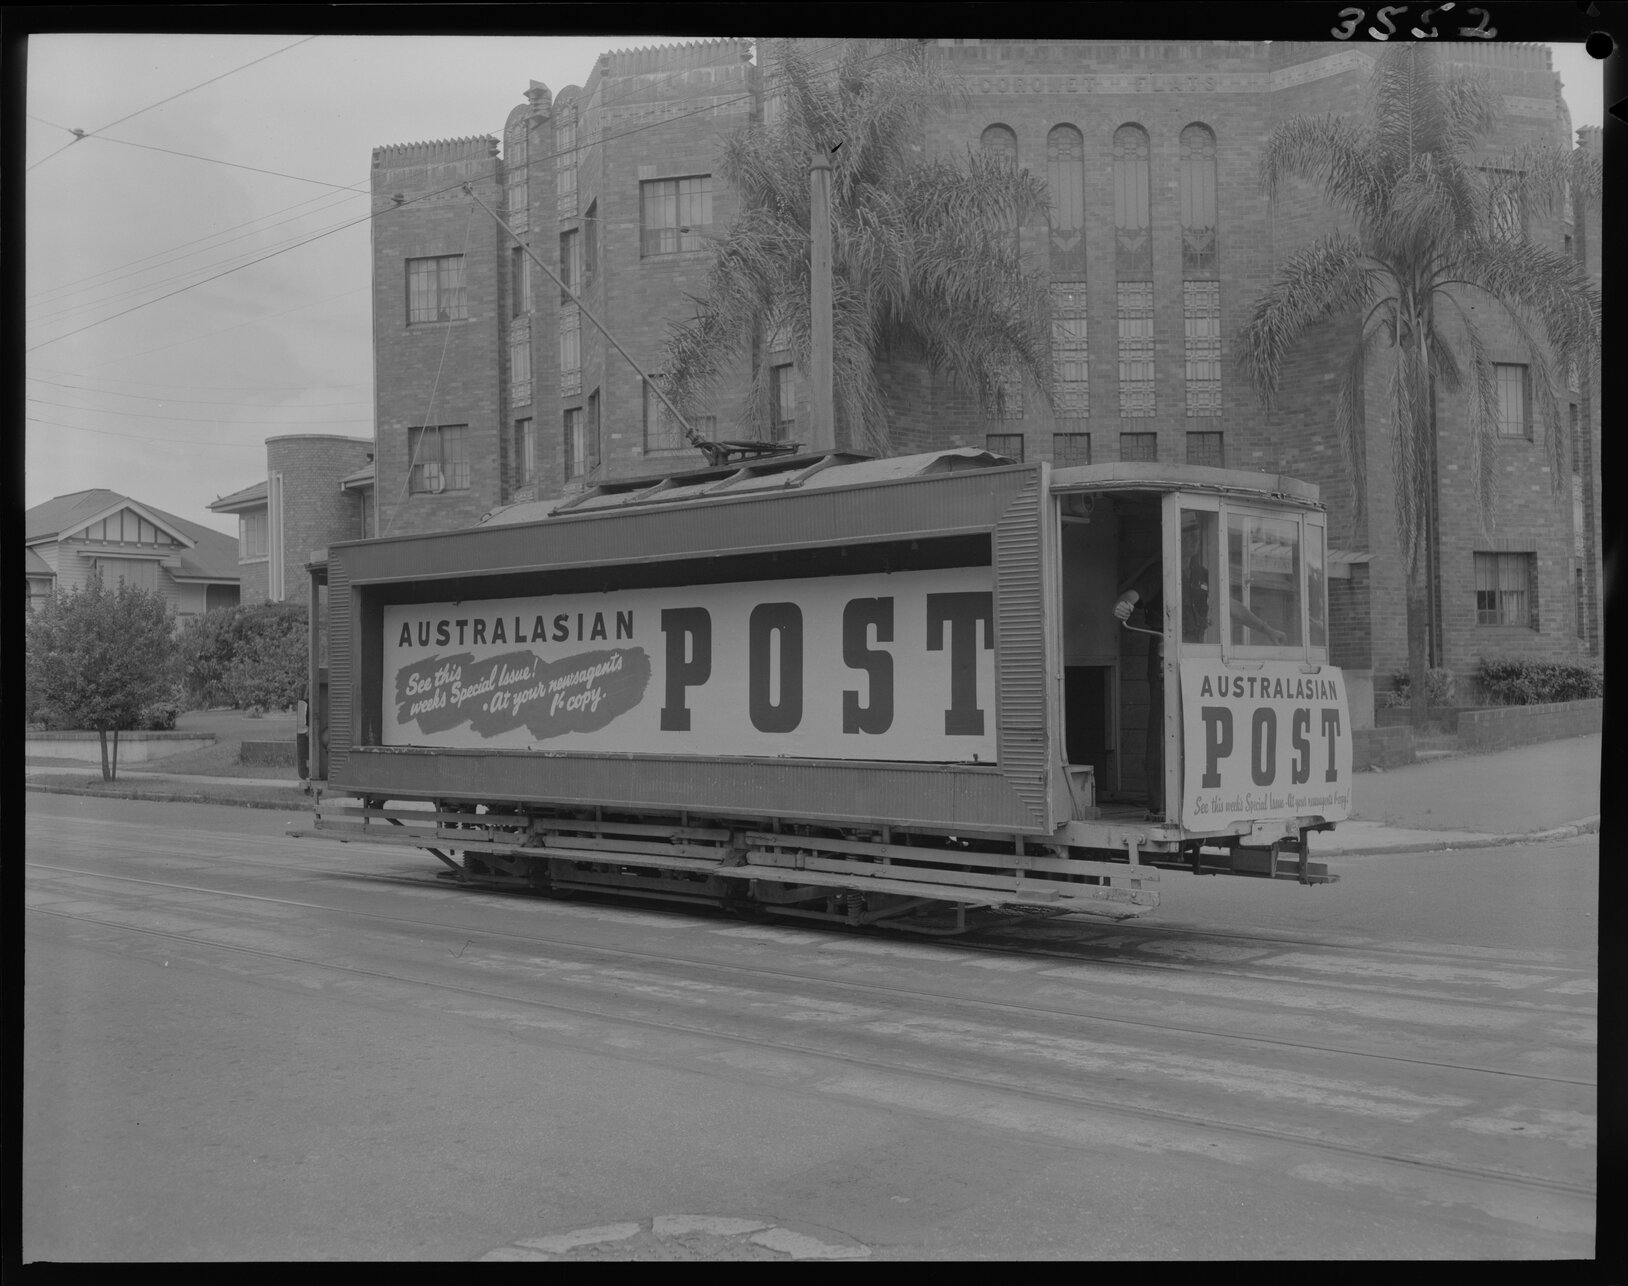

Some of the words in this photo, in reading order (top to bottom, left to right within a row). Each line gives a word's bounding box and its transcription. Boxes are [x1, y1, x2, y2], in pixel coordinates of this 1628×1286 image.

[979, 77, 1096, 94] CORONET
[1135, 76, 1216, 93] FLATS
[398, 610, 634, 648] AUSTRALASIAN
[405, 672, 433, 696] See
[434, 662, 462, 688] this
[450, 663, 498, 709] Special
[498, 656, 539, 687] Issue!
[660, 591, 995, 736] POST
[512, 681, 547, 716] your
[548, 651, 623, 690] newsagents
[1200, 675, 1338, 700] AUSTRALASIAN
[1201, 706, 1341, 789] POST
[1193, 796, 1209, 815] See
[1211, 795, 1223, 813] this
[1245, 792, 1268, 814] Special
